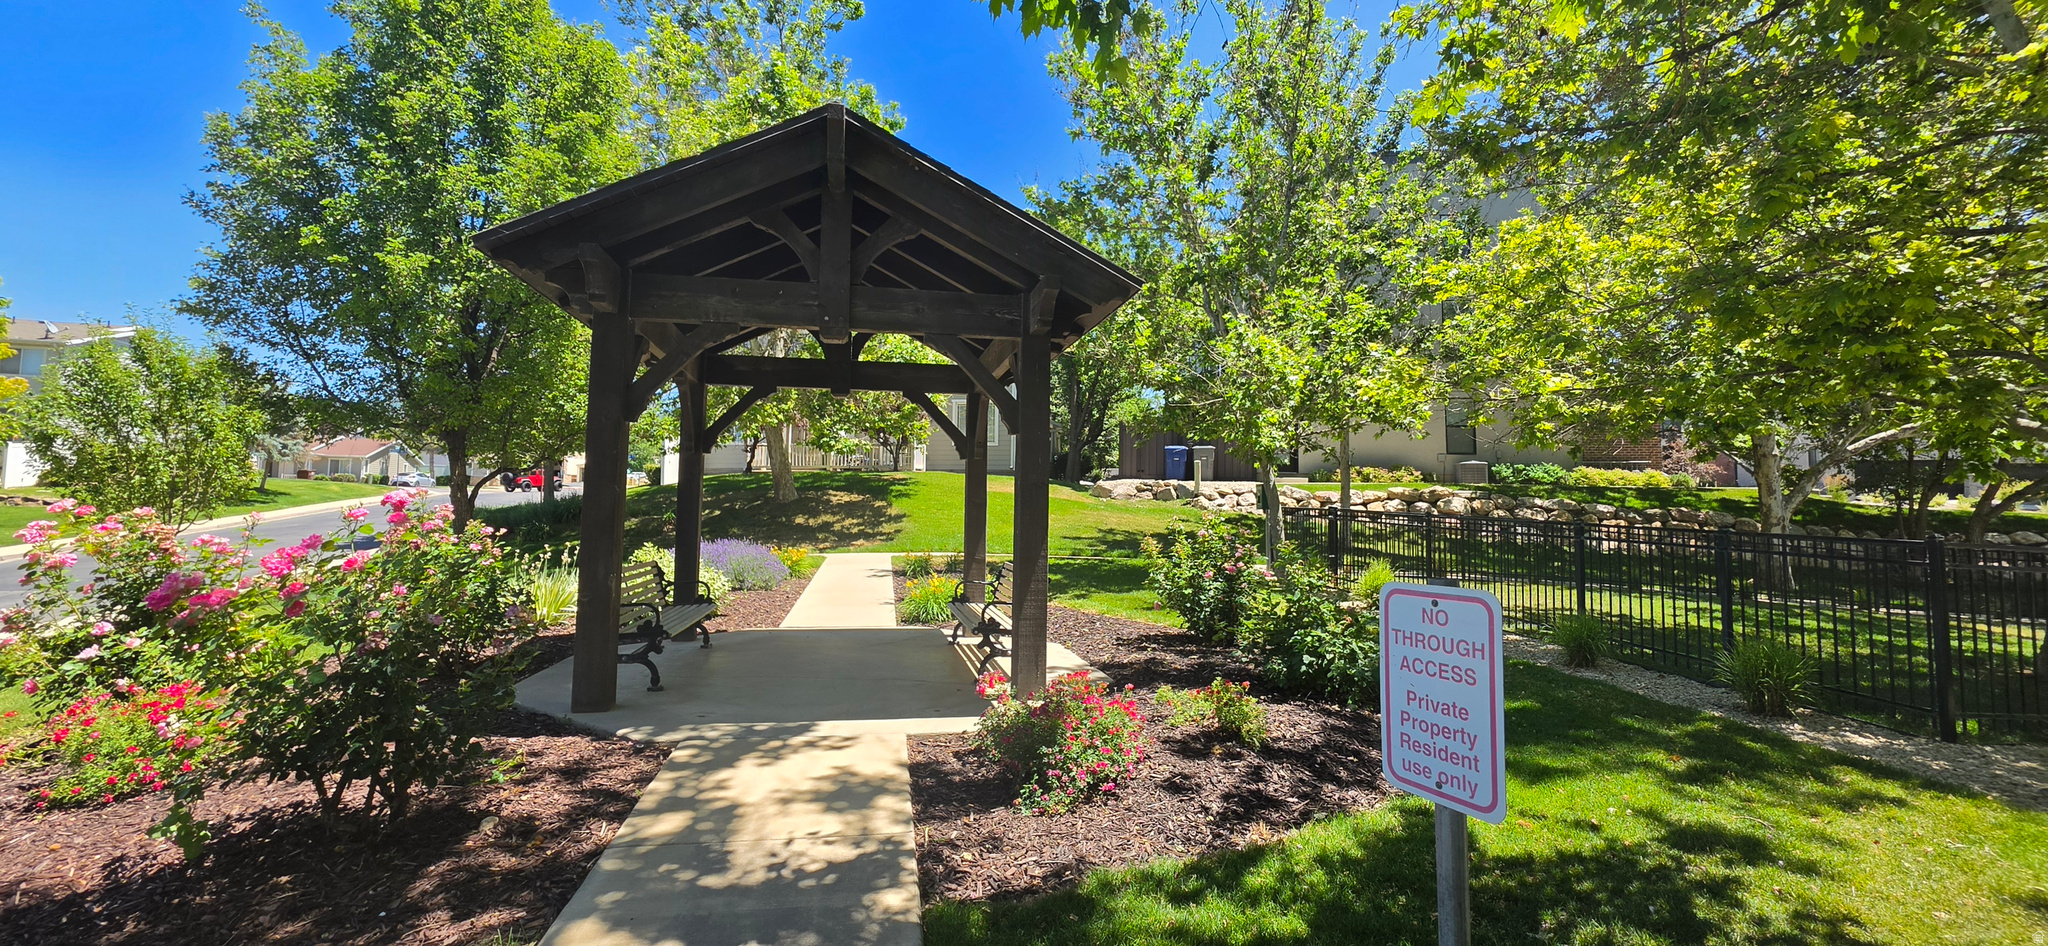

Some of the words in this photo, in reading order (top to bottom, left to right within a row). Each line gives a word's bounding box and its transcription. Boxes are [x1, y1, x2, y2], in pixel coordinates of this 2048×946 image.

[1421, 607, 1448, 626] NO
[1391, 628, 1484, 660] THROUGH
[1400, 655, 1477, 686] ACCESS
[1406, 689, 1469, 721] Private
[1400, 710, 1477, 750] Property
[1400, 731, 1479, 772] Resident
[1401, 757, 1431, 779] use
[1438, 770, 1478, 799] only
